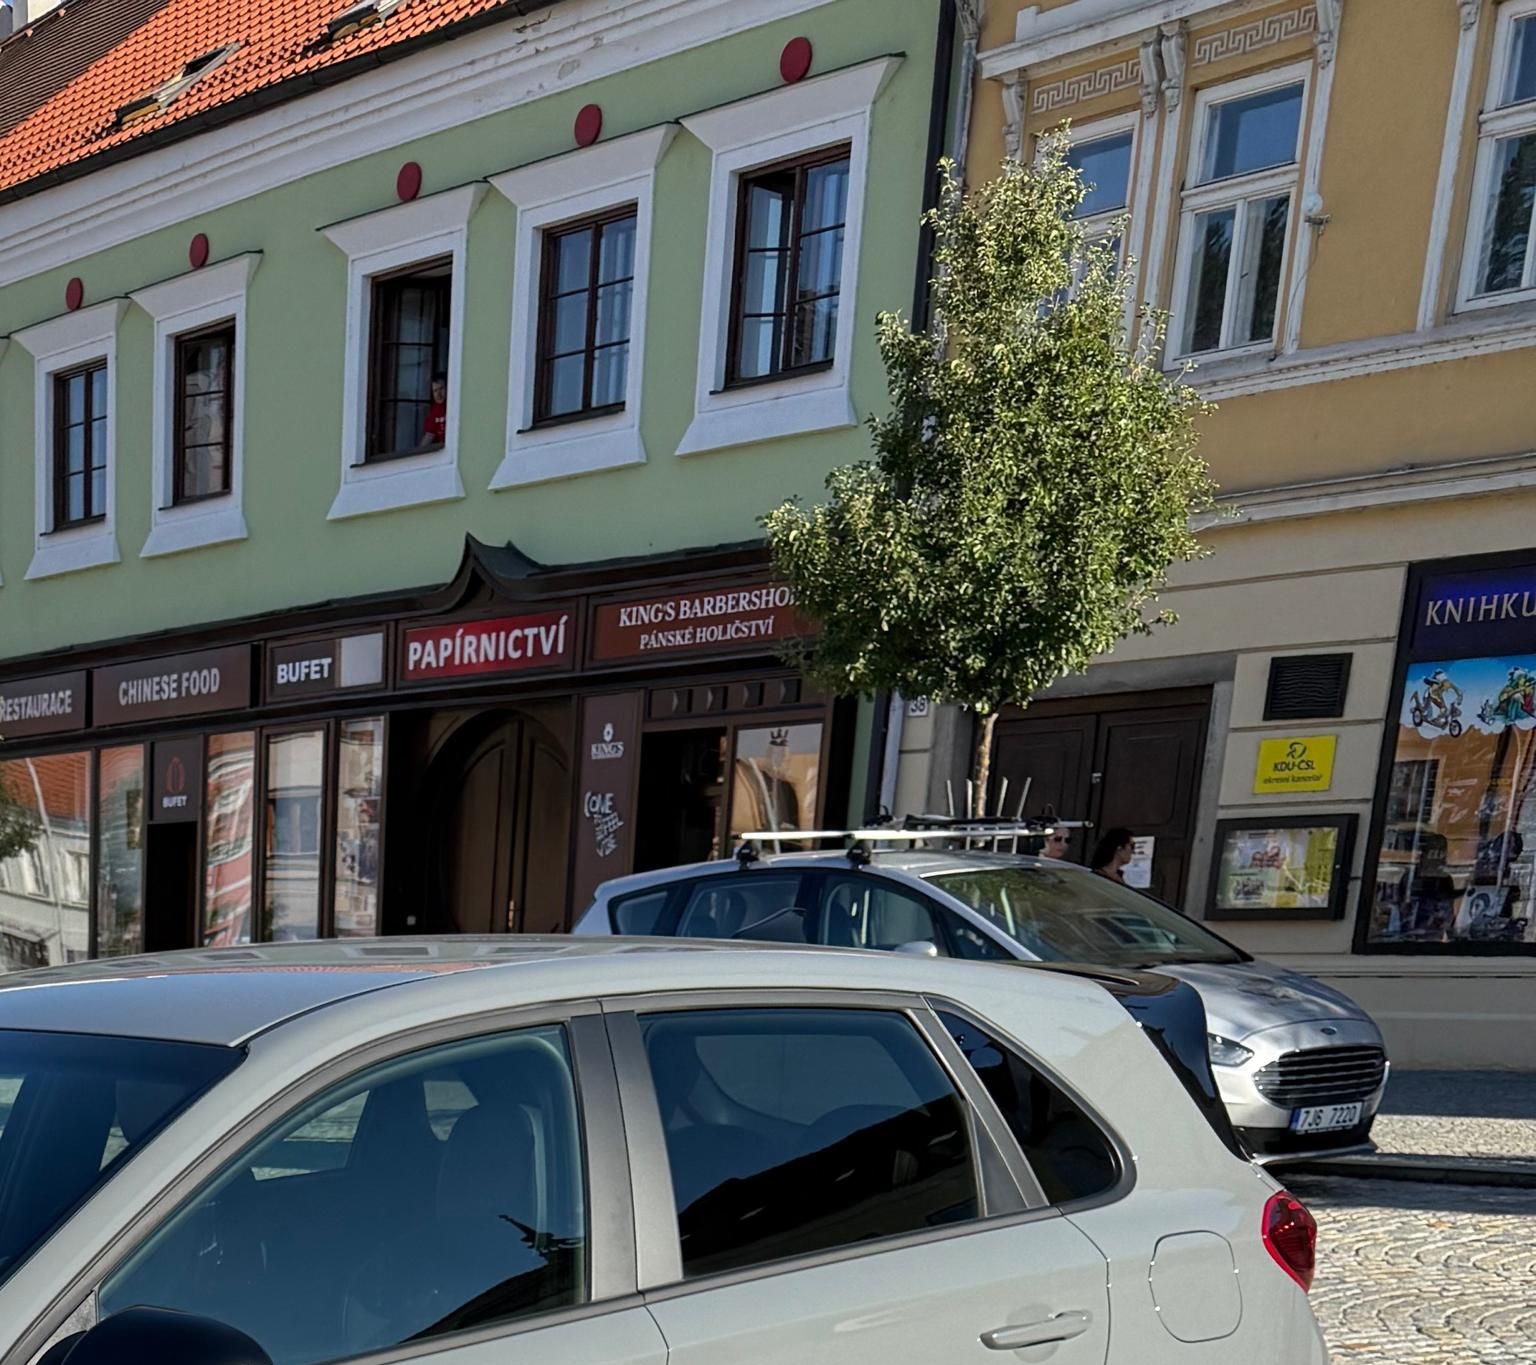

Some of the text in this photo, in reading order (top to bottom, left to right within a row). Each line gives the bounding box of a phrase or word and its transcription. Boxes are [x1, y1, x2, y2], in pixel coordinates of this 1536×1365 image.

[619, 586, 799, 627] KING'S BARBERSHO
[1425, 591, 1536, 626] KNIHKU
[408, 615, 568, 671] PAPÍRNICTVÍ
[640, 615, 774, 649] PÁNSKÉ HOLIČSTVÍ
[119, 667, 220, 705] CHINESE FOOD
[277, 657, 332, 684] BUFET
[162, 795, 188, 808] BUFET
[1302, 1109, 1324, 1128] 7J6
